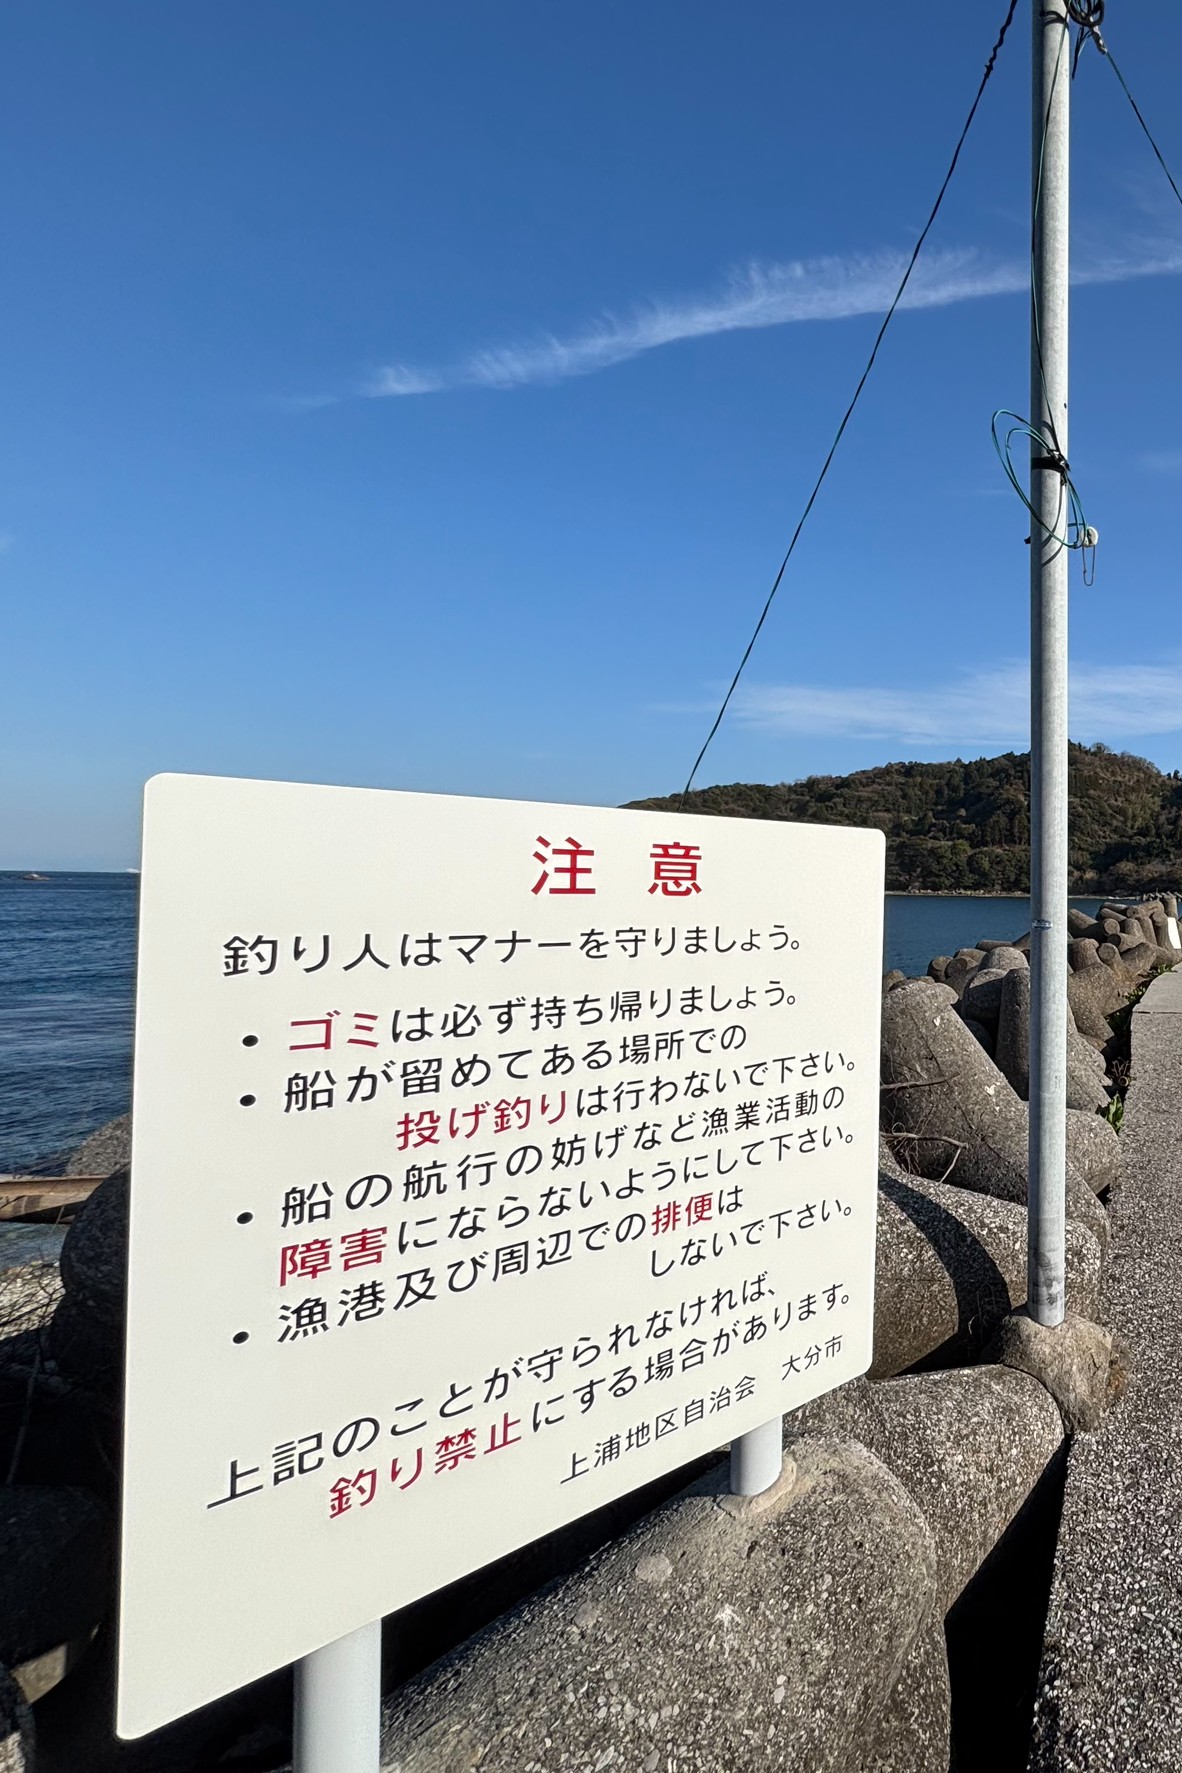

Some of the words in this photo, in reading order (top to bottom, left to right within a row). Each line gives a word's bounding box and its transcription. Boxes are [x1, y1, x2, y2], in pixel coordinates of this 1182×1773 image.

[222, 924, 800, 978] 釣り人はマナーを守りましょう。
[288, 980, 796, 1052] ゴミは必ず持ち帰りましょう。
[283, 1024, 747, 1114] 船が留めてある場所での
[395, 1050, 855, 1152] 投げ釣りは行わないで下さい。
[279, 1125, 854, 1288] 障害にならないようにして下さい。
[280, 1085, 845, 1229] 船の航行の妨げなど漁業活動の
[276, 1184, 744, 1344] 漁港及び周辺での排便は
[650, 1199, 852, 1278] しないで下さい。
[206, 1270, 776, 1510] 上記のことが守られなければ、
[328, 1283, 850, 1520] 釣り禁止にする場合があります。
[559, 1375, 756, 1485] 上浦地区自治会
[779, 1334, 843, 1381] 大分市
